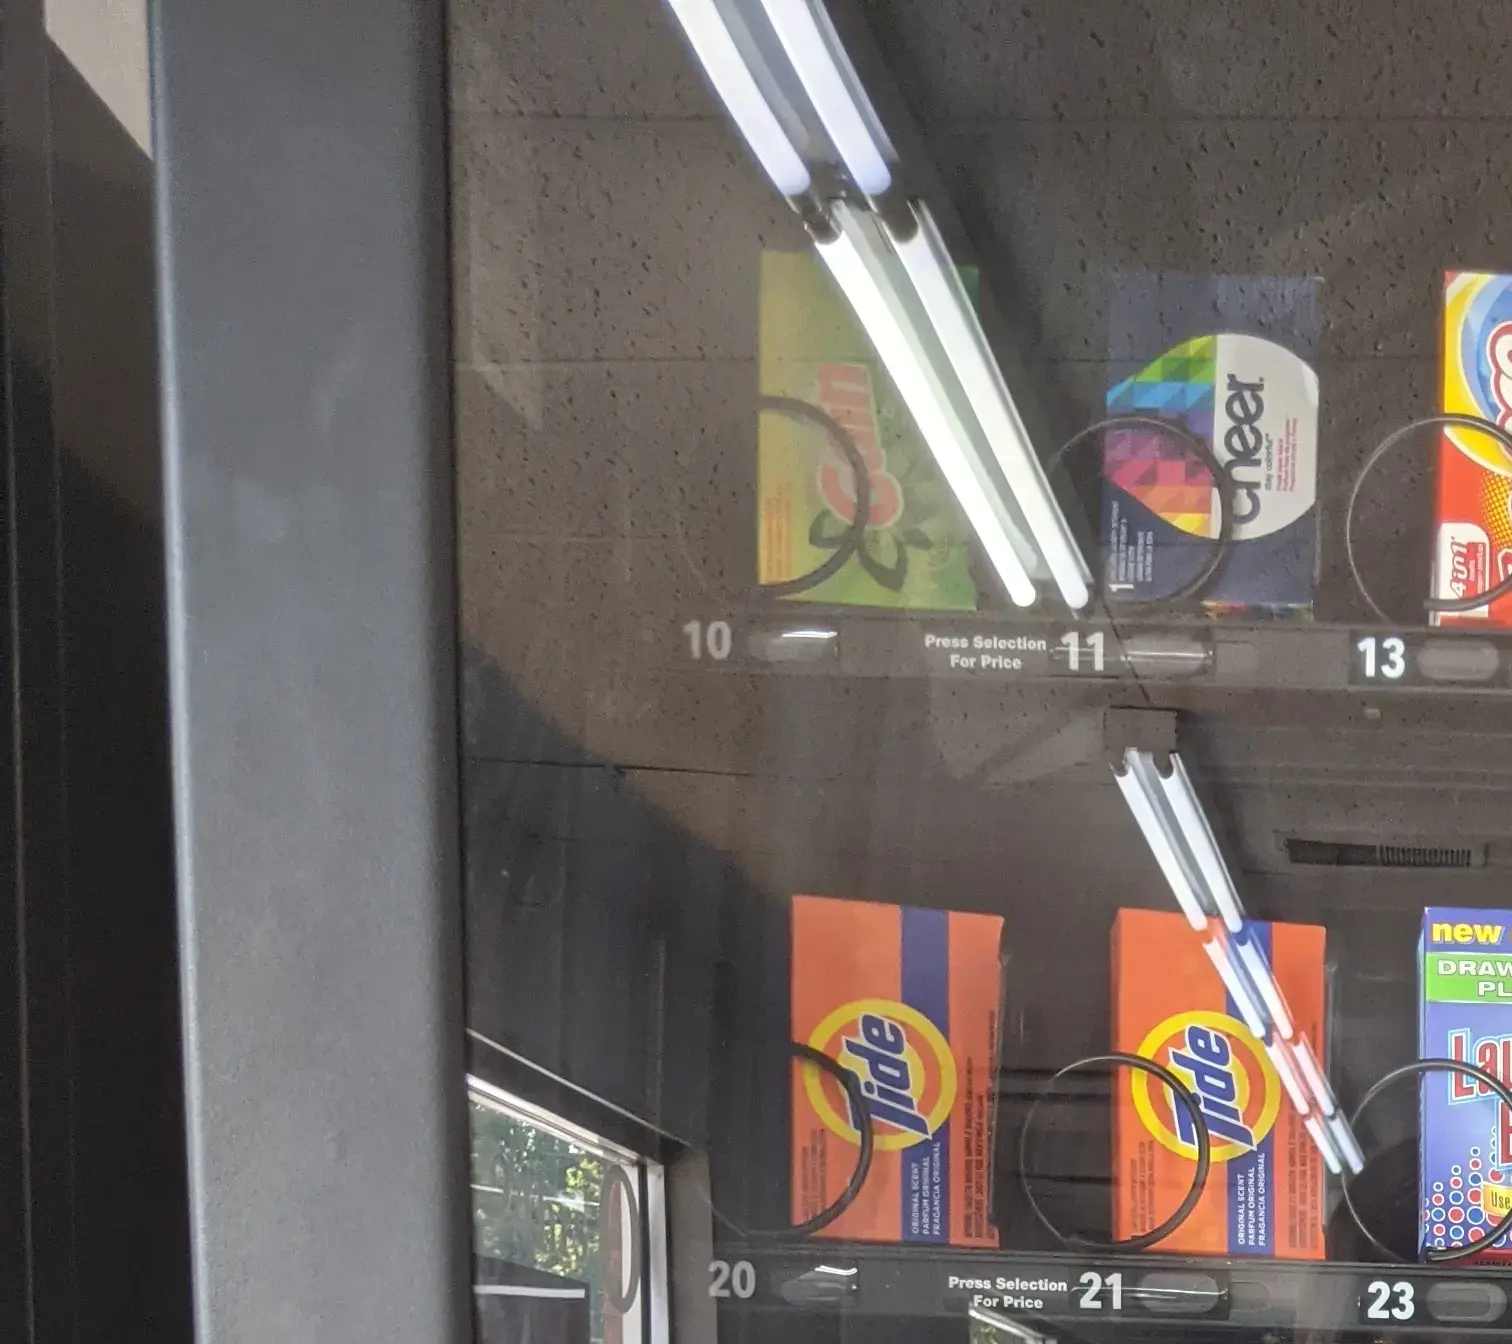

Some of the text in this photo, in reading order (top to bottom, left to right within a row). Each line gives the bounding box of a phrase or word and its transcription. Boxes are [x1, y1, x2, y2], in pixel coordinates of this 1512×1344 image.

[683, 621, 731, 658] 10
[1060, 632, 1104, 671] 11
[1358, 637, 1405, 677] 13
[1432, 921, 1501, 947] new
[843, 1012, 932, 1140] Tide
[1166, 1022, 1257, 1150] Tide
[1237, 1173, 1246, 1245] ORIGINAL SCENT
[1247, 1167, 1256, 1246] PARFUM ORIGINAL
[1257, 1153, 1267, 1246] FRAGANCIA ORIGINAL
[709, 1262, 756, 1297] 20
[948, 1277, 1067, 1292] Press Selection
[1079, 1272, 1122, 1309] 21
[973, 1295, 1043, 1309] For Price
[1367, 1282, 1414, 1319] 23
